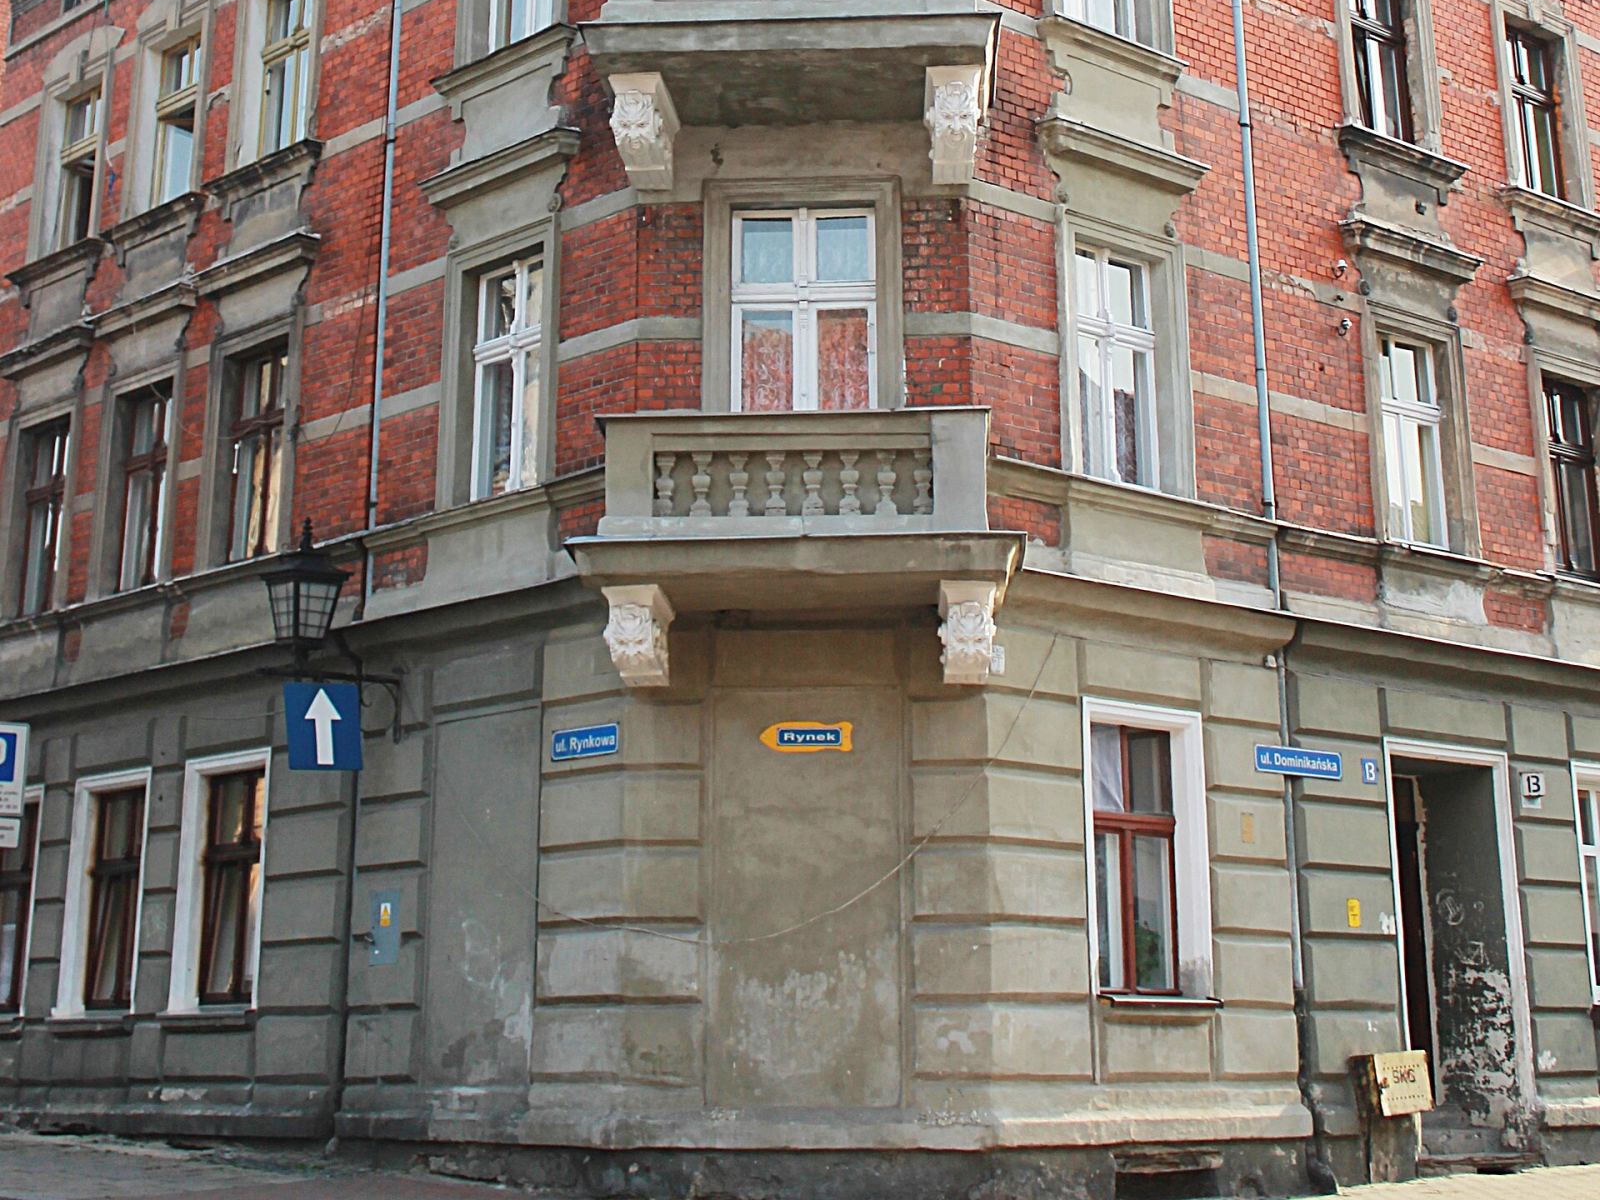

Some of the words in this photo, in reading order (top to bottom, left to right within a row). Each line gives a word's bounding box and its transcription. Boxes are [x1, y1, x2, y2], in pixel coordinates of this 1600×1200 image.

[555, 738, 566, 752] ul.
[569, 734, 615, 753] Rynkowa
[783, 732, 836, 743] Rynek
[1260, 752, 1272, 765] ul.
[1274, 753, 1337, 772] Dominikańska
[1526, 775, 1541, 793] 13
